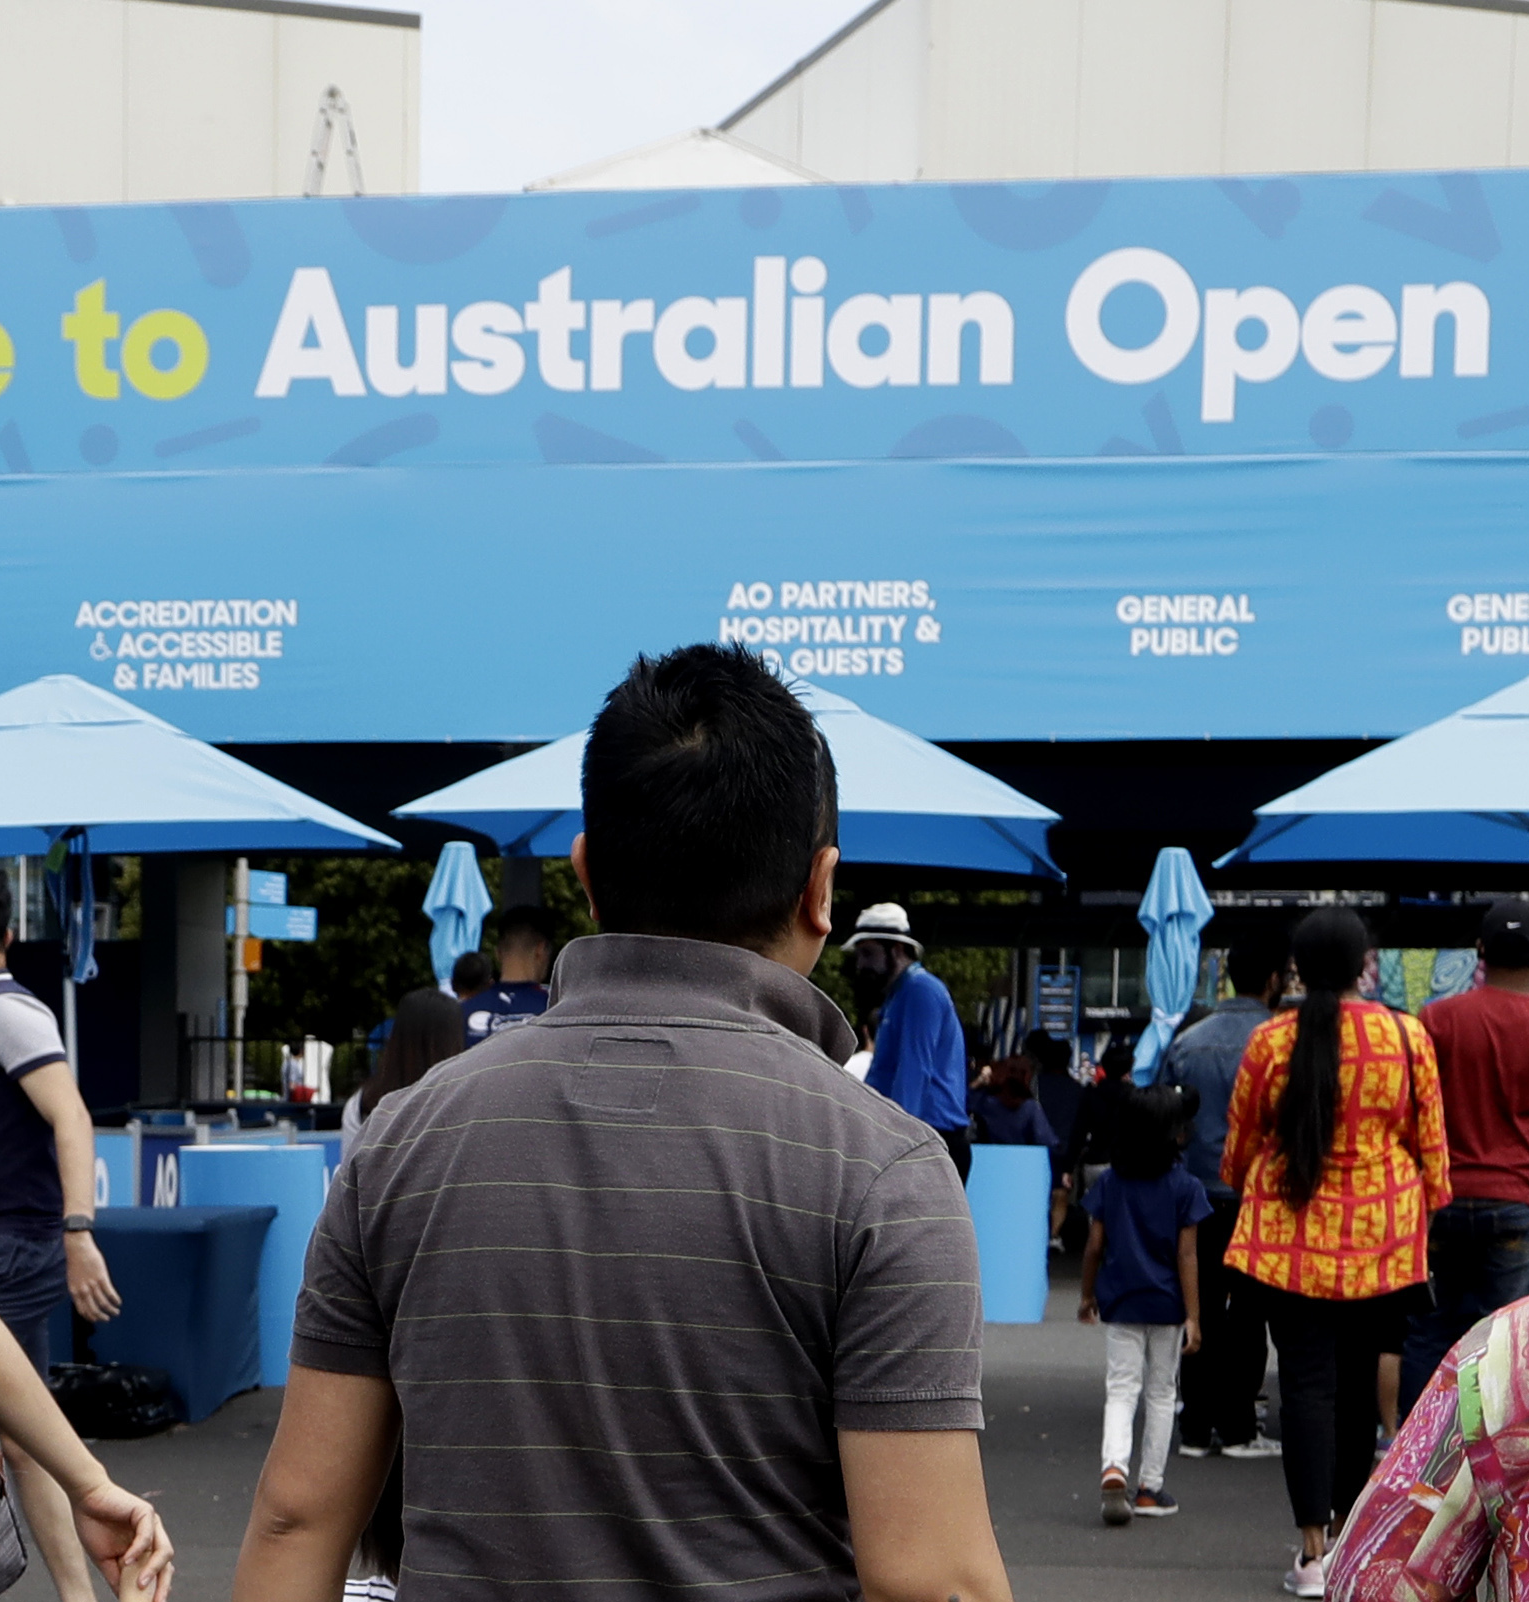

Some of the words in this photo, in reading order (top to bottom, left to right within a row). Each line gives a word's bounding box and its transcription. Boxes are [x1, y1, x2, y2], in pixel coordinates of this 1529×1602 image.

[62, 279, 209, 400] to
[254, 256, 1015, 398] Australian
[1065, 247, 1491, 422] Open
[727, 582, 774, 610] AO
[780, 580, 936, 611] PARTNERS,
[1116, 594, 1256, 623] GENERAL
[74, 599, 298, 628] ACCREDITATION
[719, 616, 907, 644] HOSPITALITY
[914, 615, 942, 643] &
[1130, 628, 1239, 656] PUBLIC
[116, 630, 283, 659] ACCESSIBLE
[789, 647, 905, 676] GUESTS
[113, 662, 138, 691] &
[142, 662, 261, 690] FAMILIES
